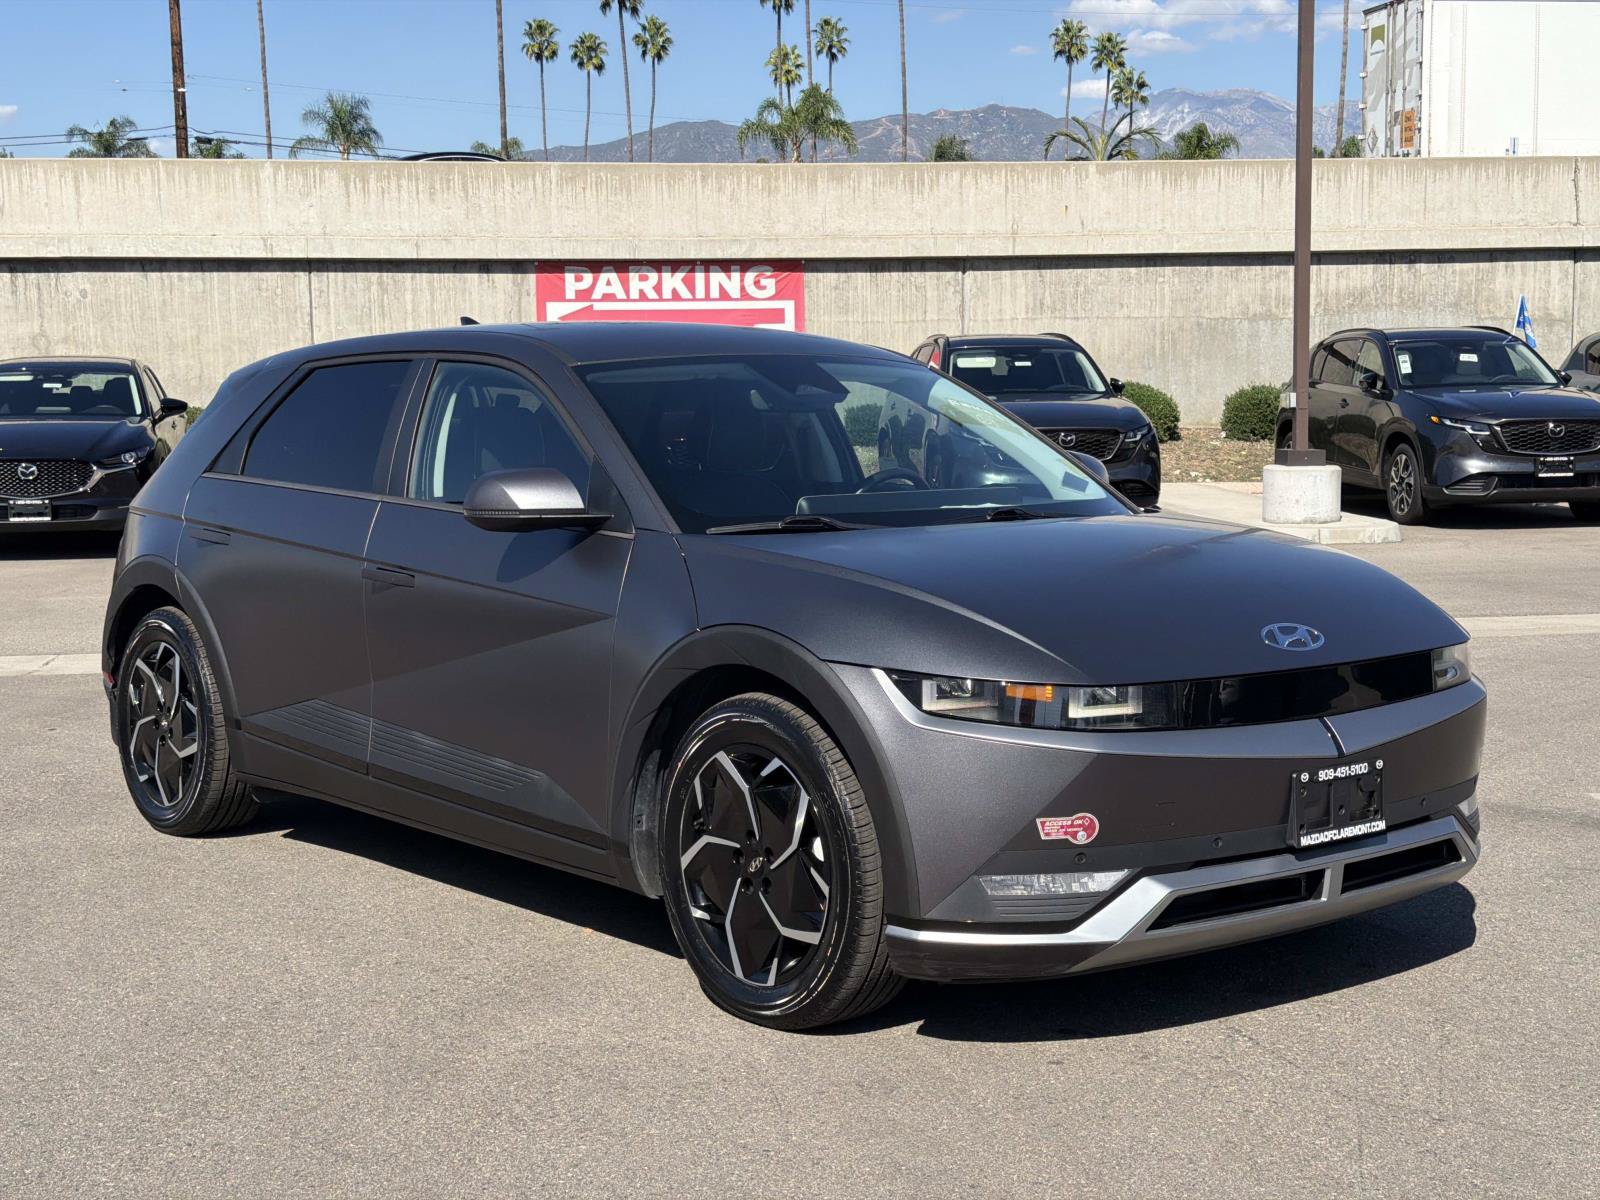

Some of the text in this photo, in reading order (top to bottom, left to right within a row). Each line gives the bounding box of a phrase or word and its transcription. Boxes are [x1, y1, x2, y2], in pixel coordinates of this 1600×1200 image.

[564, 265, 776, 300] PARKING
[1318, 763, 1369, 781] 909-451-5100
[1301, 820, 1386, 846] MAZDAOFCLAREMONT.COM
